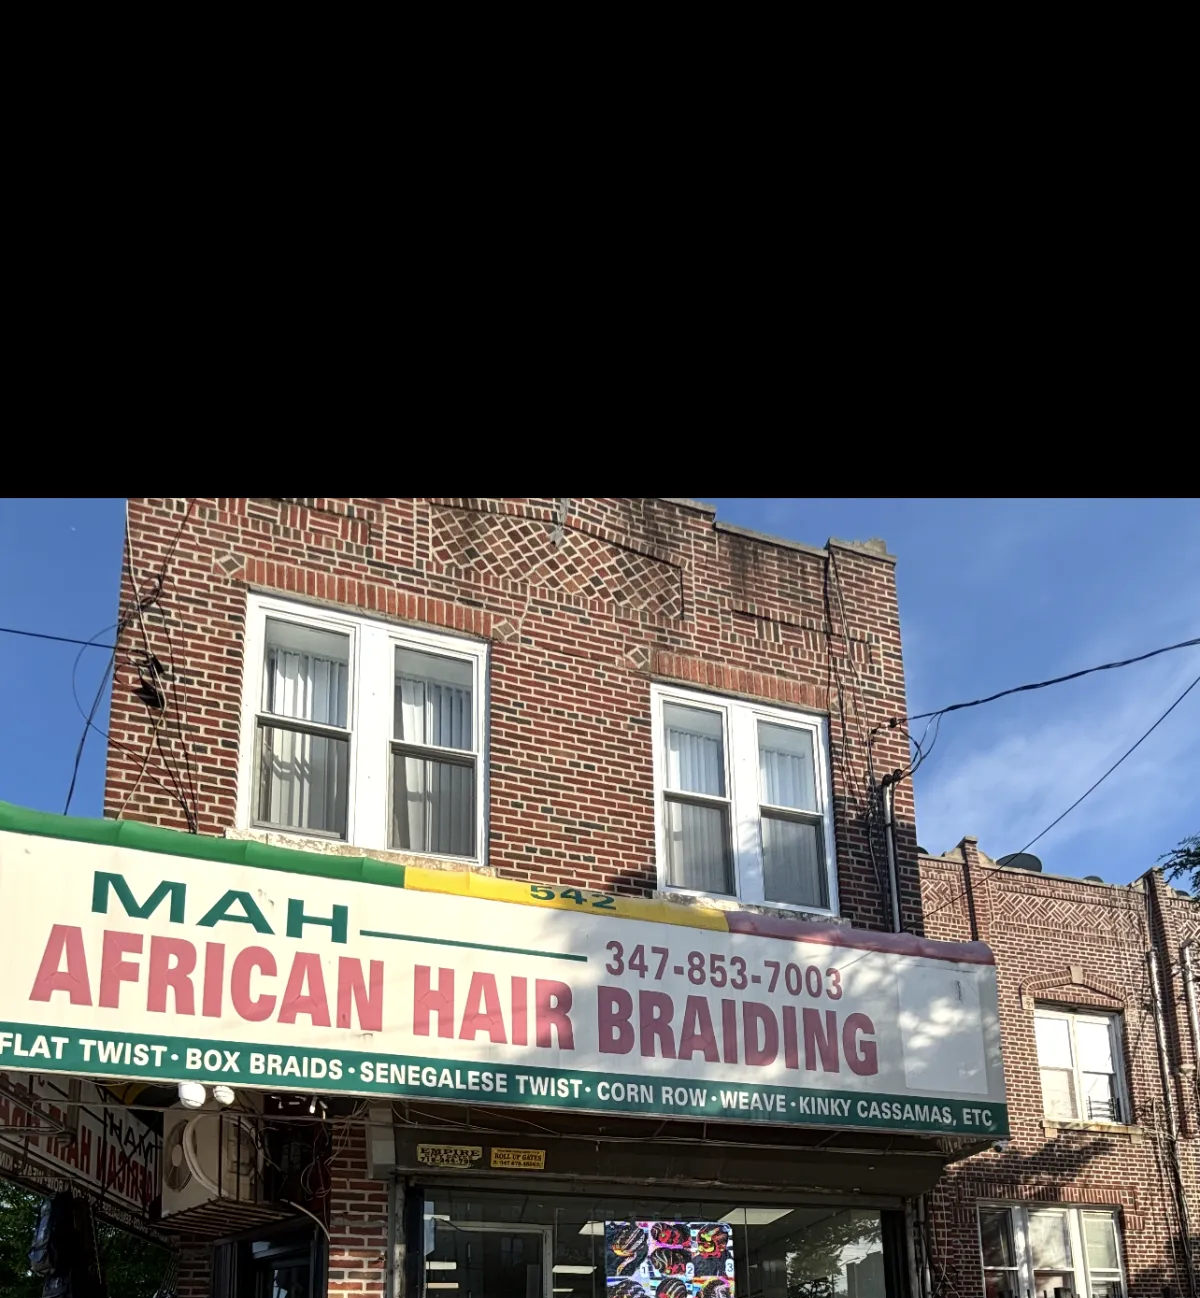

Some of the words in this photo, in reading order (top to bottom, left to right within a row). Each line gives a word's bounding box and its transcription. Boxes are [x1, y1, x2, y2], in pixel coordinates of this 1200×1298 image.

[91, 870, 349, 944] MAH
[530, 884, 617, 910] 542
[29, 924, 384, 1032] AFRICAN
[412, 964, 573, 1050] HAIR
[597, 985, 879, 1076] BRAIDING
[605, 940, 843, 1001] 347-853-7003
[0, 1031, 69, 1060] FLAT
[78, 1038, 168, 1067] TWIST
[185, 1047, 241, 1073] BOX
[249, 1052, 343, 1080] BRAIDS
[360, 1061, 507, 1094] SENEGALESE
[515, 1075, 583, 1099] TWIST
[597, 1081, 654, 1104] CORN
[661, 1086, 707, 1108] ROW
[719, 1090, 787, 1113] WEAVE
[799, 1096, 852, 1117] KINKY
[857, 1100, 957, 1126] CASSAMAS,
[963, 1107, 993, 1127] ETC
[421, 1148, 480, 1156] EMPIRE
